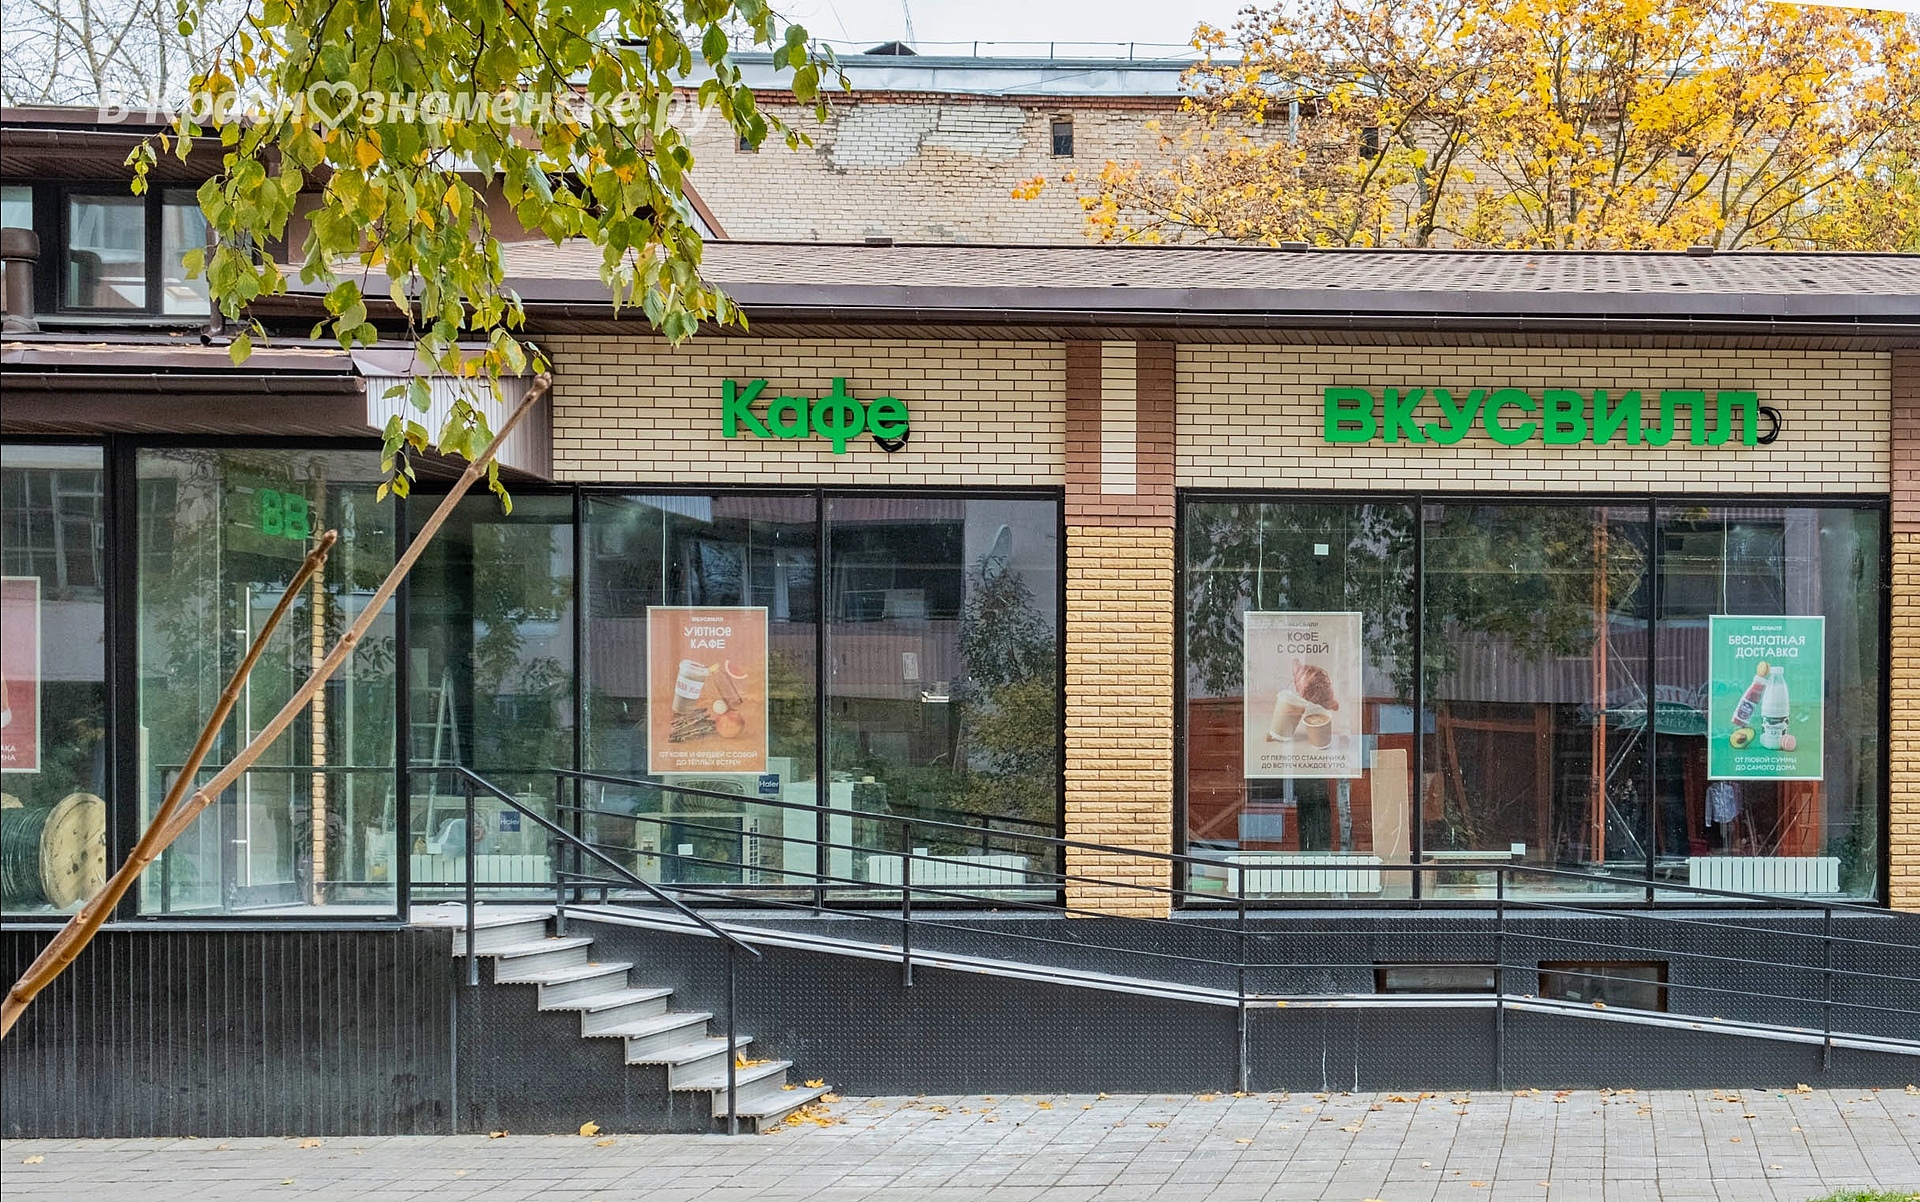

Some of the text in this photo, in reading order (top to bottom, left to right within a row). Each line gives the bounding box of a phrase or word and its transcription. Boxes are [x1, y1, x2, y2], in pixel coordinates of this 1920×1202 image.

[722, 377, 909, 455] Кафе
[1324, 387, 1758, 446] ВКУСВИЛЛ
[1287, 631, 1319, 642] КОФЕ
[690, 639, 726, 649] КАФЕ
[1287, 642, 1330, 654] СОБОЙ
[1735, 647, 1799, 659] ДОСТАВКА
[759, 780, 779, 788] Haier
